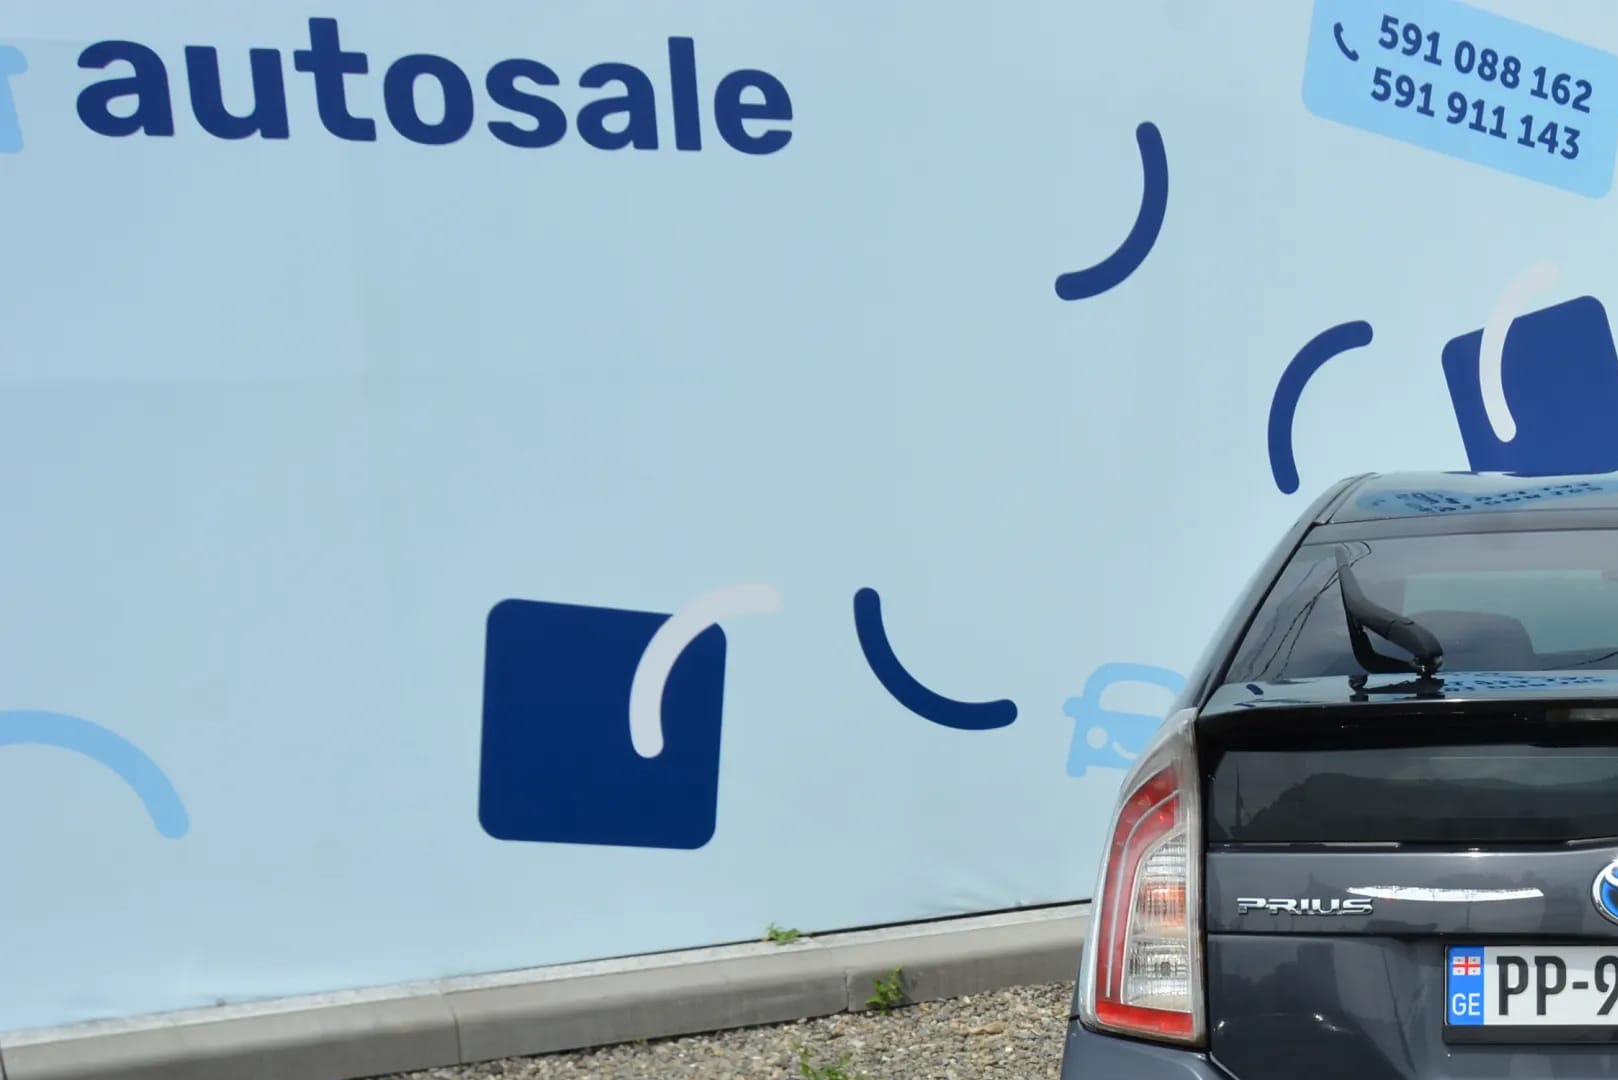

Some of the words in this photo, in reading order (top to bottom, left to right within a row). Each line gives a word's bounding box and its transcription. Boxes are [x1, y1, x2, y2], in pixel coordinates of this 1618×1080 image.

[76, 17, 793, 155] autosale
[1378, 14, 1443, 67] 591
[1454, 40, 1522, 90] 088
[1529, 65, 1593, 114] 162
[1370, 66, 1435, 118] 591
[1446, 91, 1508, 140] 911
[1517, 114, 1581, 160] 143
[1236, 898, 1374, 915] PRIUS
[1452, 993, 1481, 1016] GE
